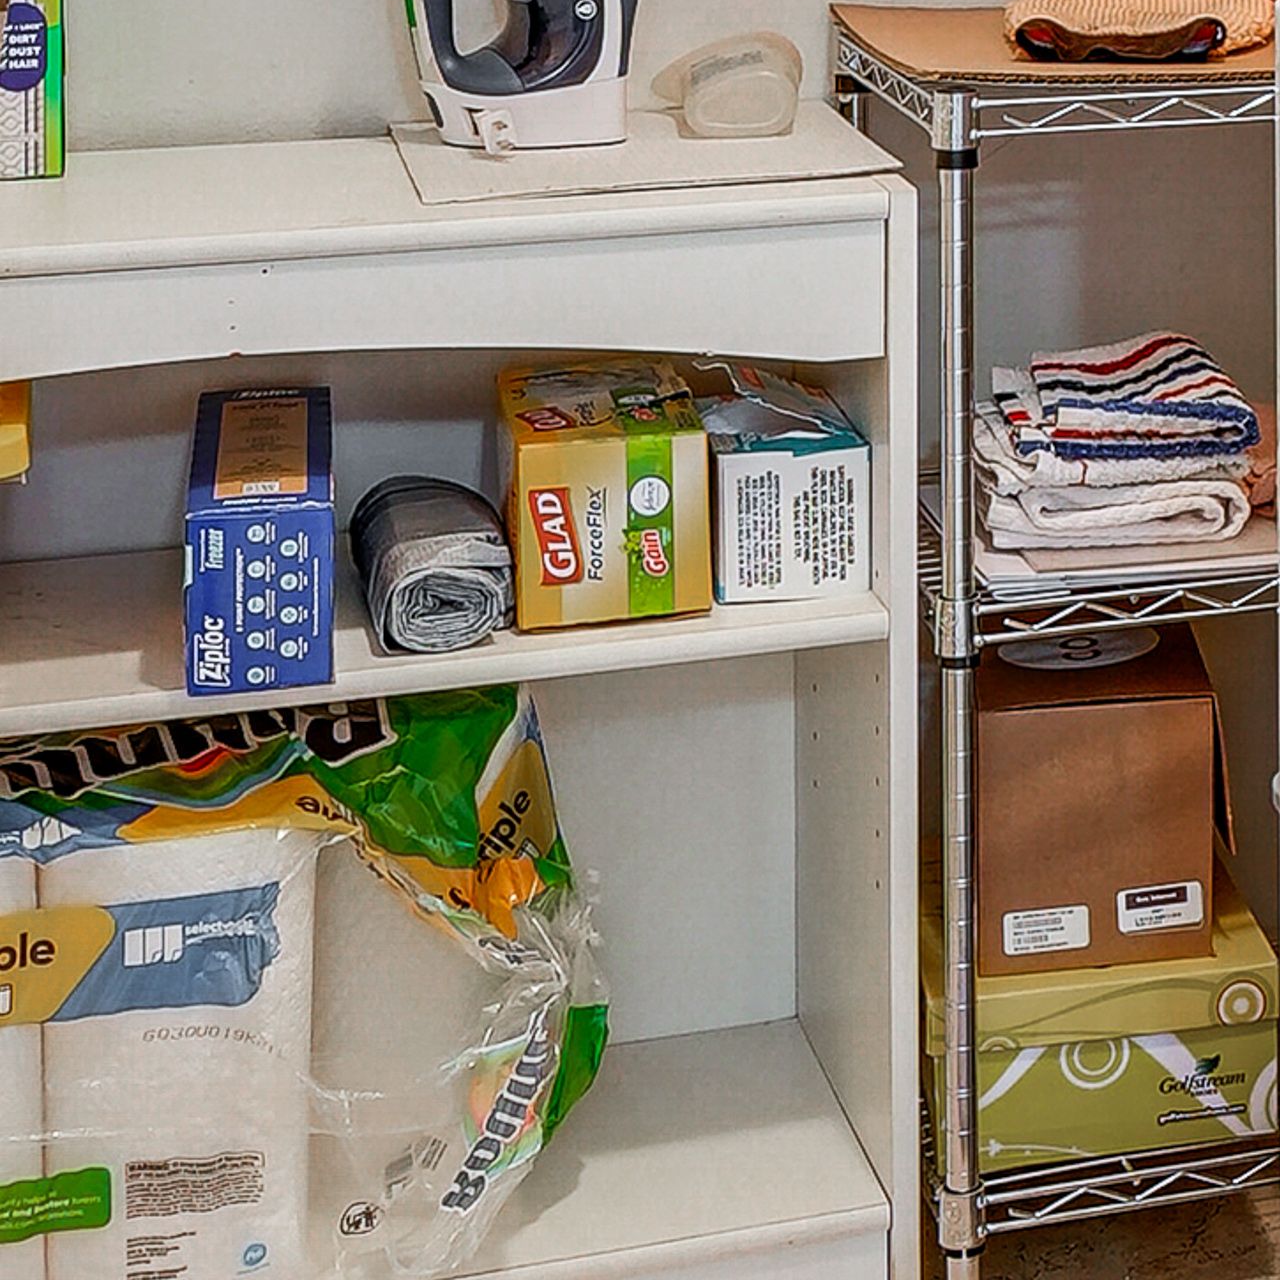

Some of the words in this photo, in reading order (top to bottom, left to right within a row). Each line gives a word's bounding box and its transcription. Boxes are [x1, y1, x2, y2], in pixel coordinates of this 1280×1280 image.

[9, 34, 37, 45] DIRT
[9, 46, 41, 57] DUST
[9, 59, 39, 70] HAIR
[536, 492, 578, 579] GLAD
[586, 484, 604, 582] ForceFlex
[641, 530, 670, 577] Gain
[198, 615, 230, 682] Ziploc
[1159, 1072, 1246, 1097] Golfstream
